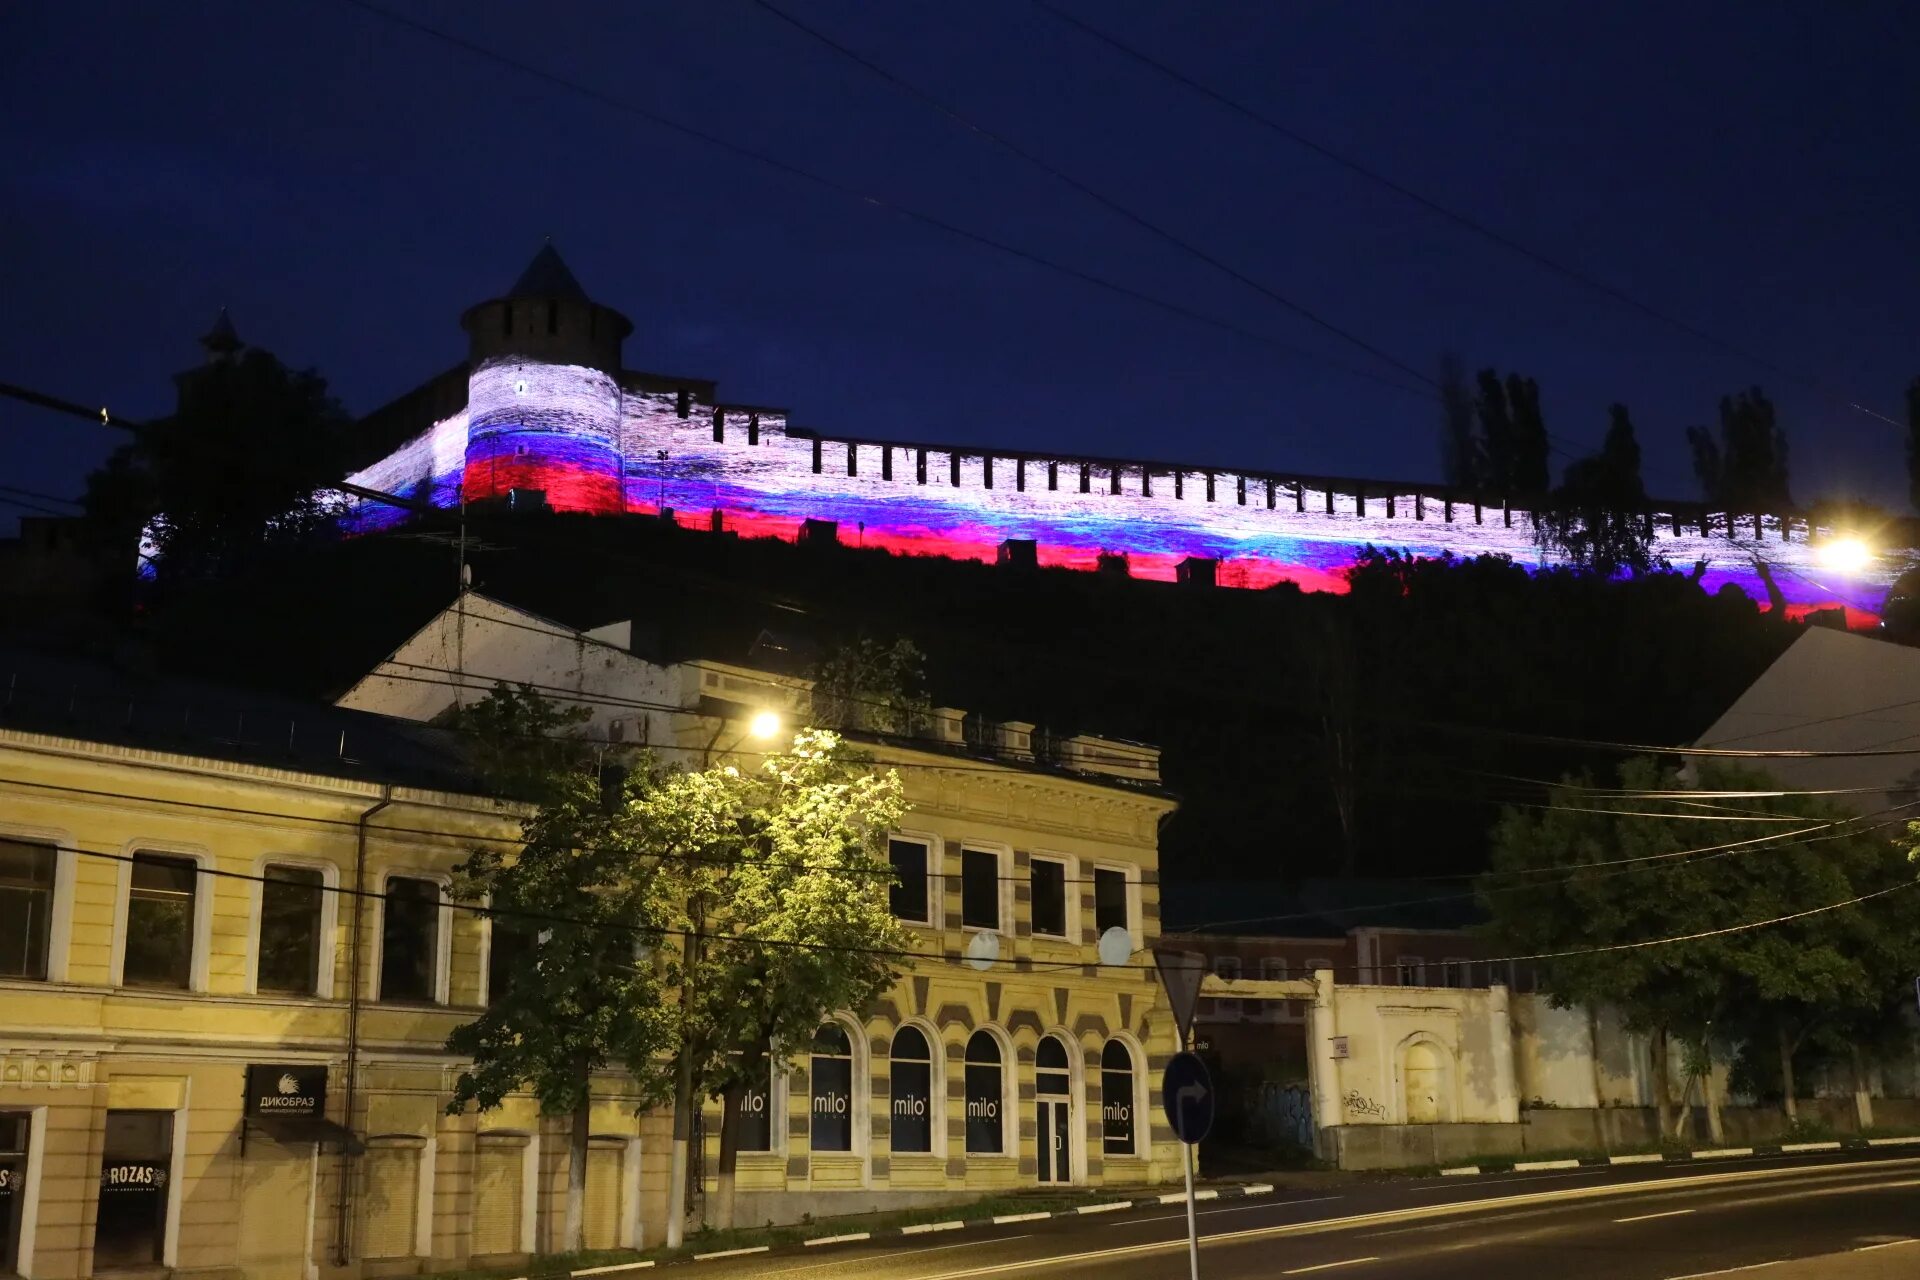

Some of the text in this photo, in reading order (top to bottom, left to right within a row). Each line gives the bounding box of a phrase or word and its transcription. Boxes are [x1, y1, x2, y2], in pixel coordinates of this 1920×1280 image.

[260, 1096, 315, 1108] ДИКОБРАЗ
[814, 1092, 846, 1113] milo
[894, 1094, 925, 1116] milo
[968, 1097, 996, 1117] milo
[1103, 1101, 1129, 1121] milo
[110, 1166, 153, 1184] ROZAS
